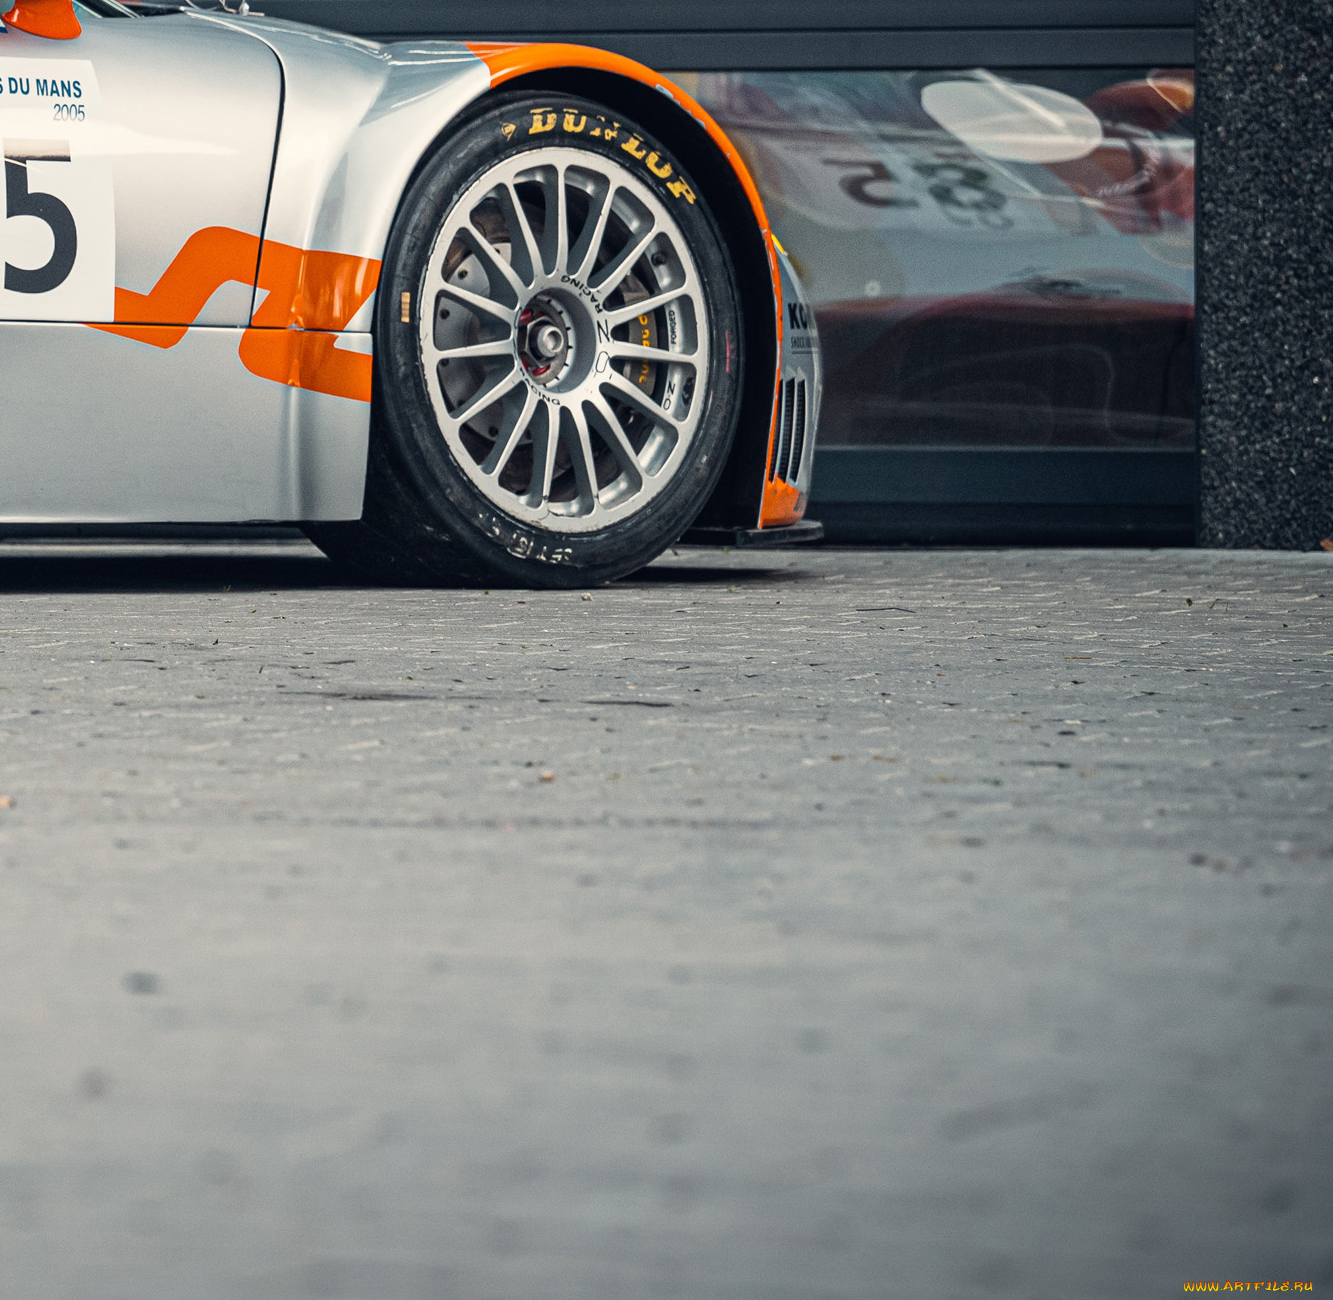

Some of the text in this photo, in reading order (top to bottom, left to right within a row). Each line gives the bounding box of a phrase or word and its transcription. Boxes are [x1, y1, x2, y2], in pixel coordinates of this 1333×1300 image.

[8, 76, 31, 96] DU
[36, 78, 83, 99] MANS
[53, 103, 85, 122] 2005
[560, 274, 603, 314] RACING
